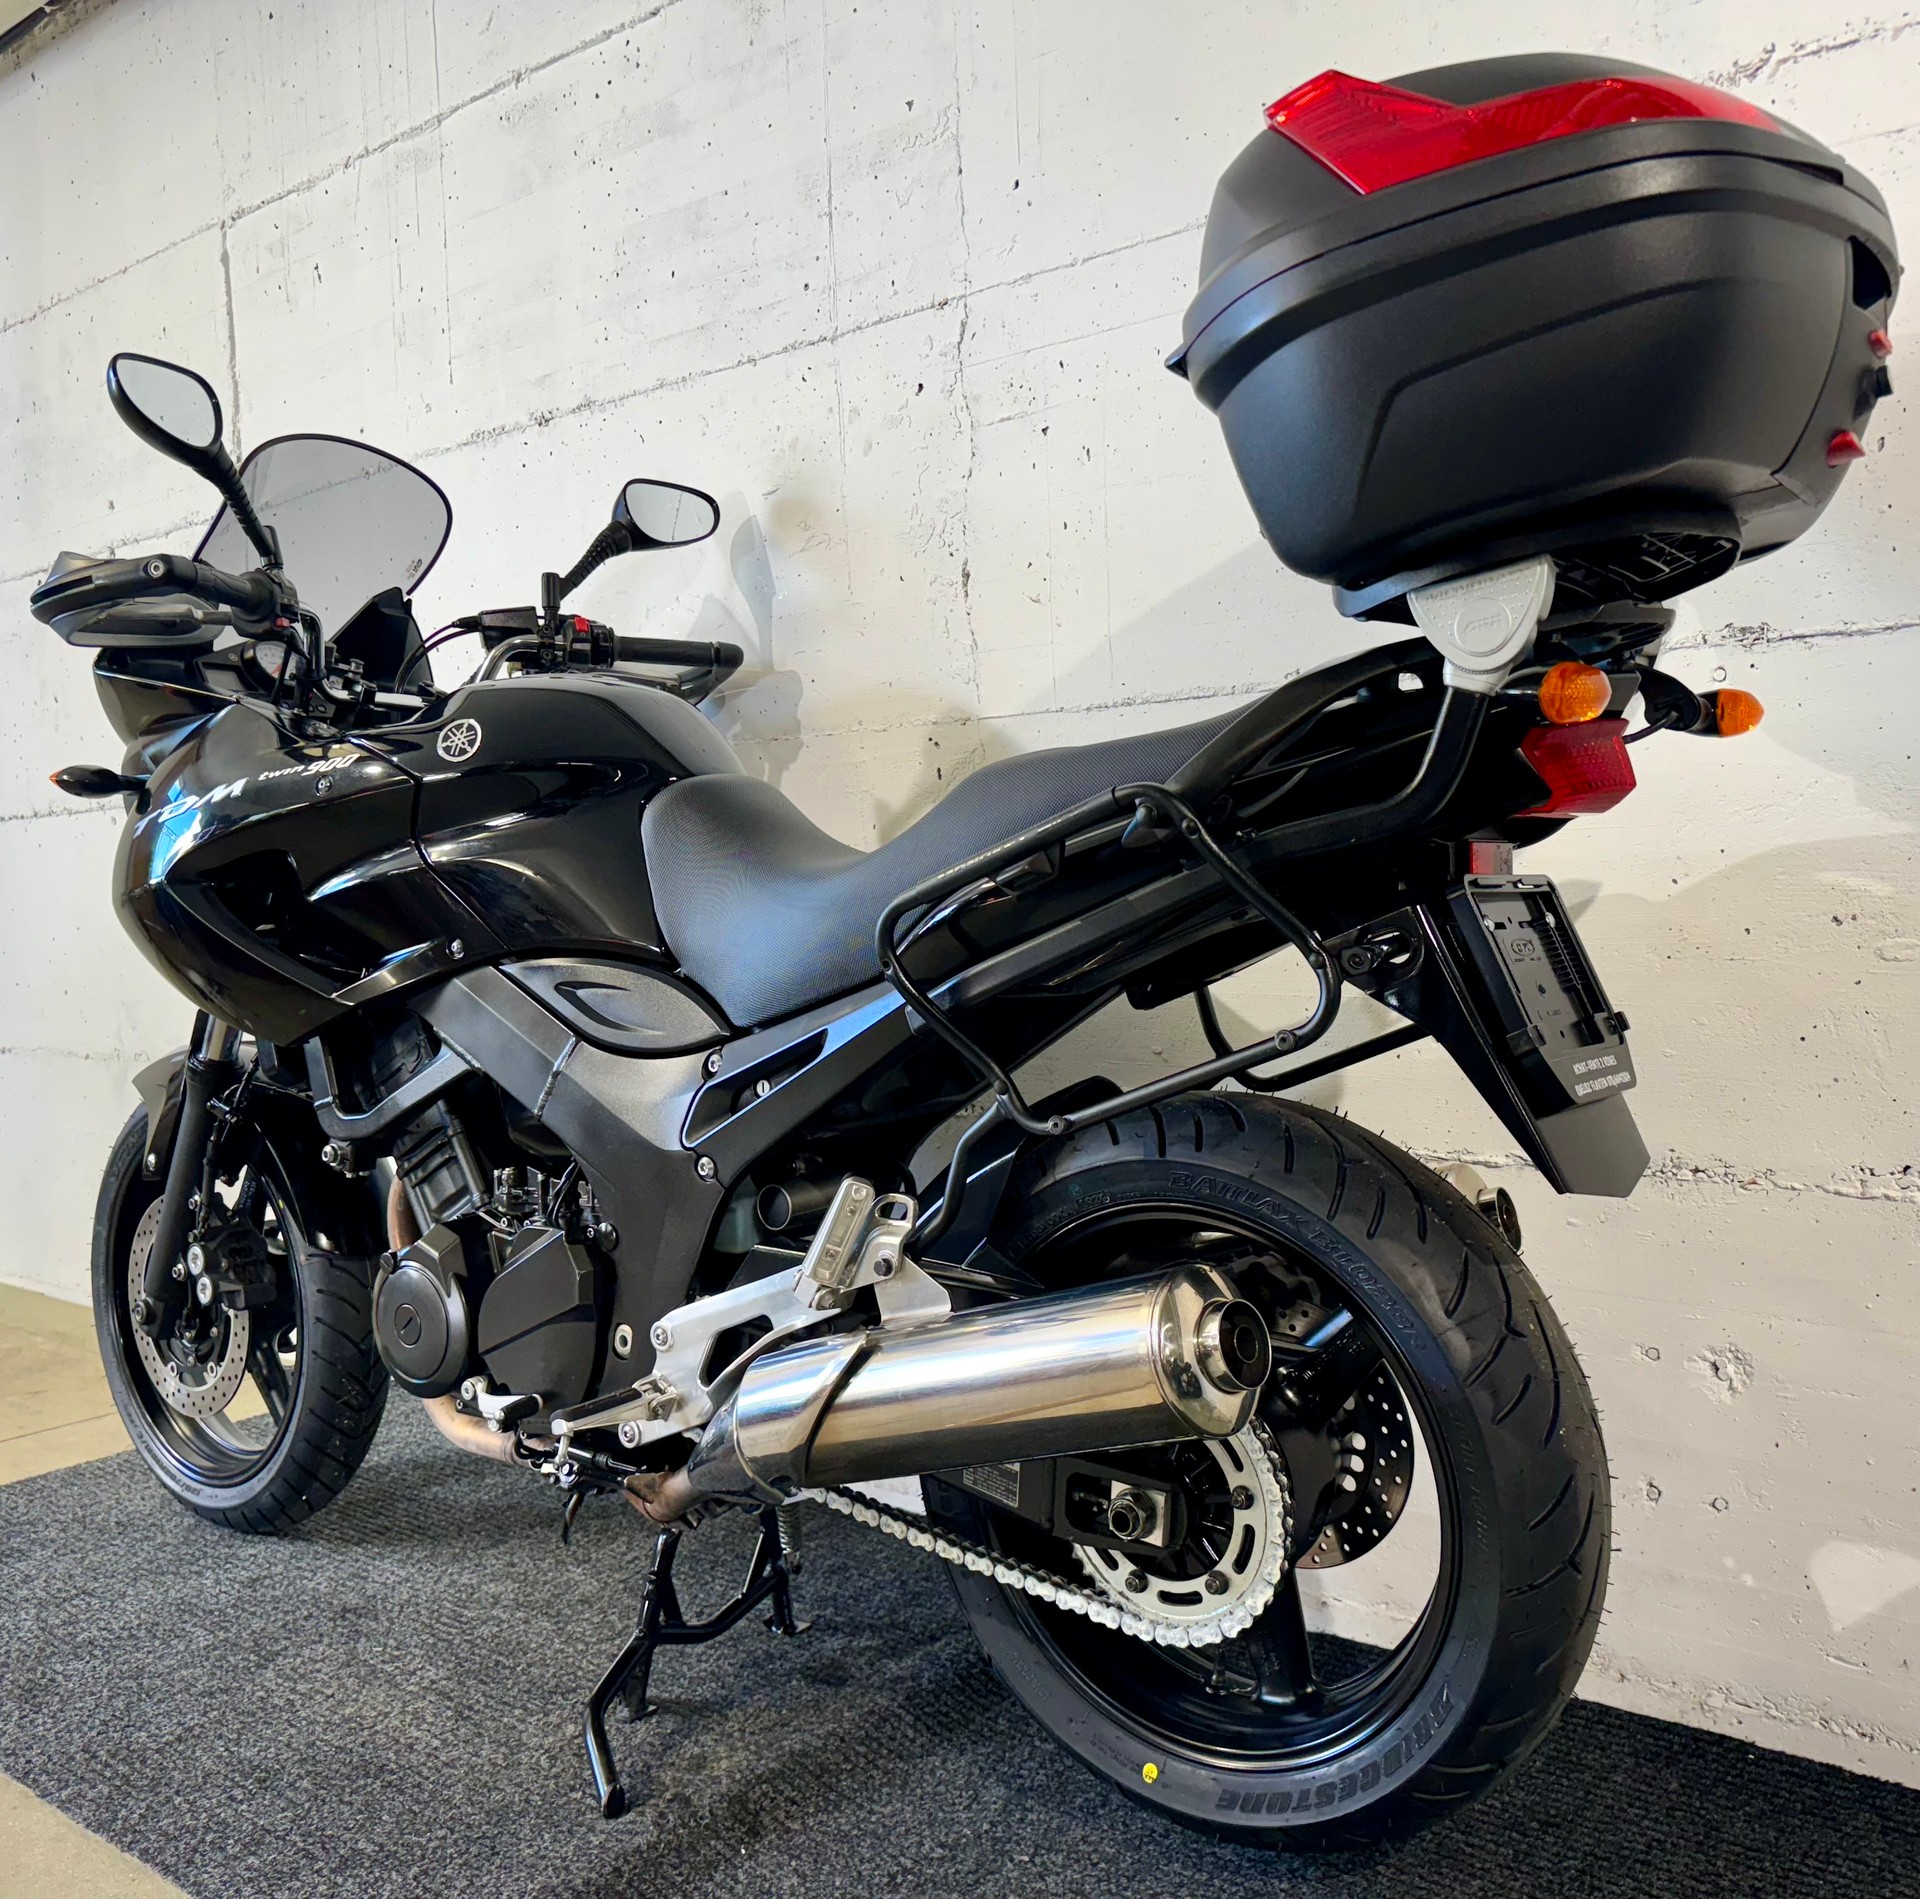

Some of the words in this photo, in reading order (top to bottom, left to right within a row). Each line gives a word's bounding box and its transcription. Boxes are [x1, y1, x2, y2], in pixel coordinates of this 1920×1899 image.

[257, 765, 307, 782] twin
[301, 753, 361, 777] 900
[132, 776, 250, 840] TDM
[1168, 1170, 1306, 1232] BATTLAX
[1214, 1681, 1454, 1816] BRIDGESTONE
